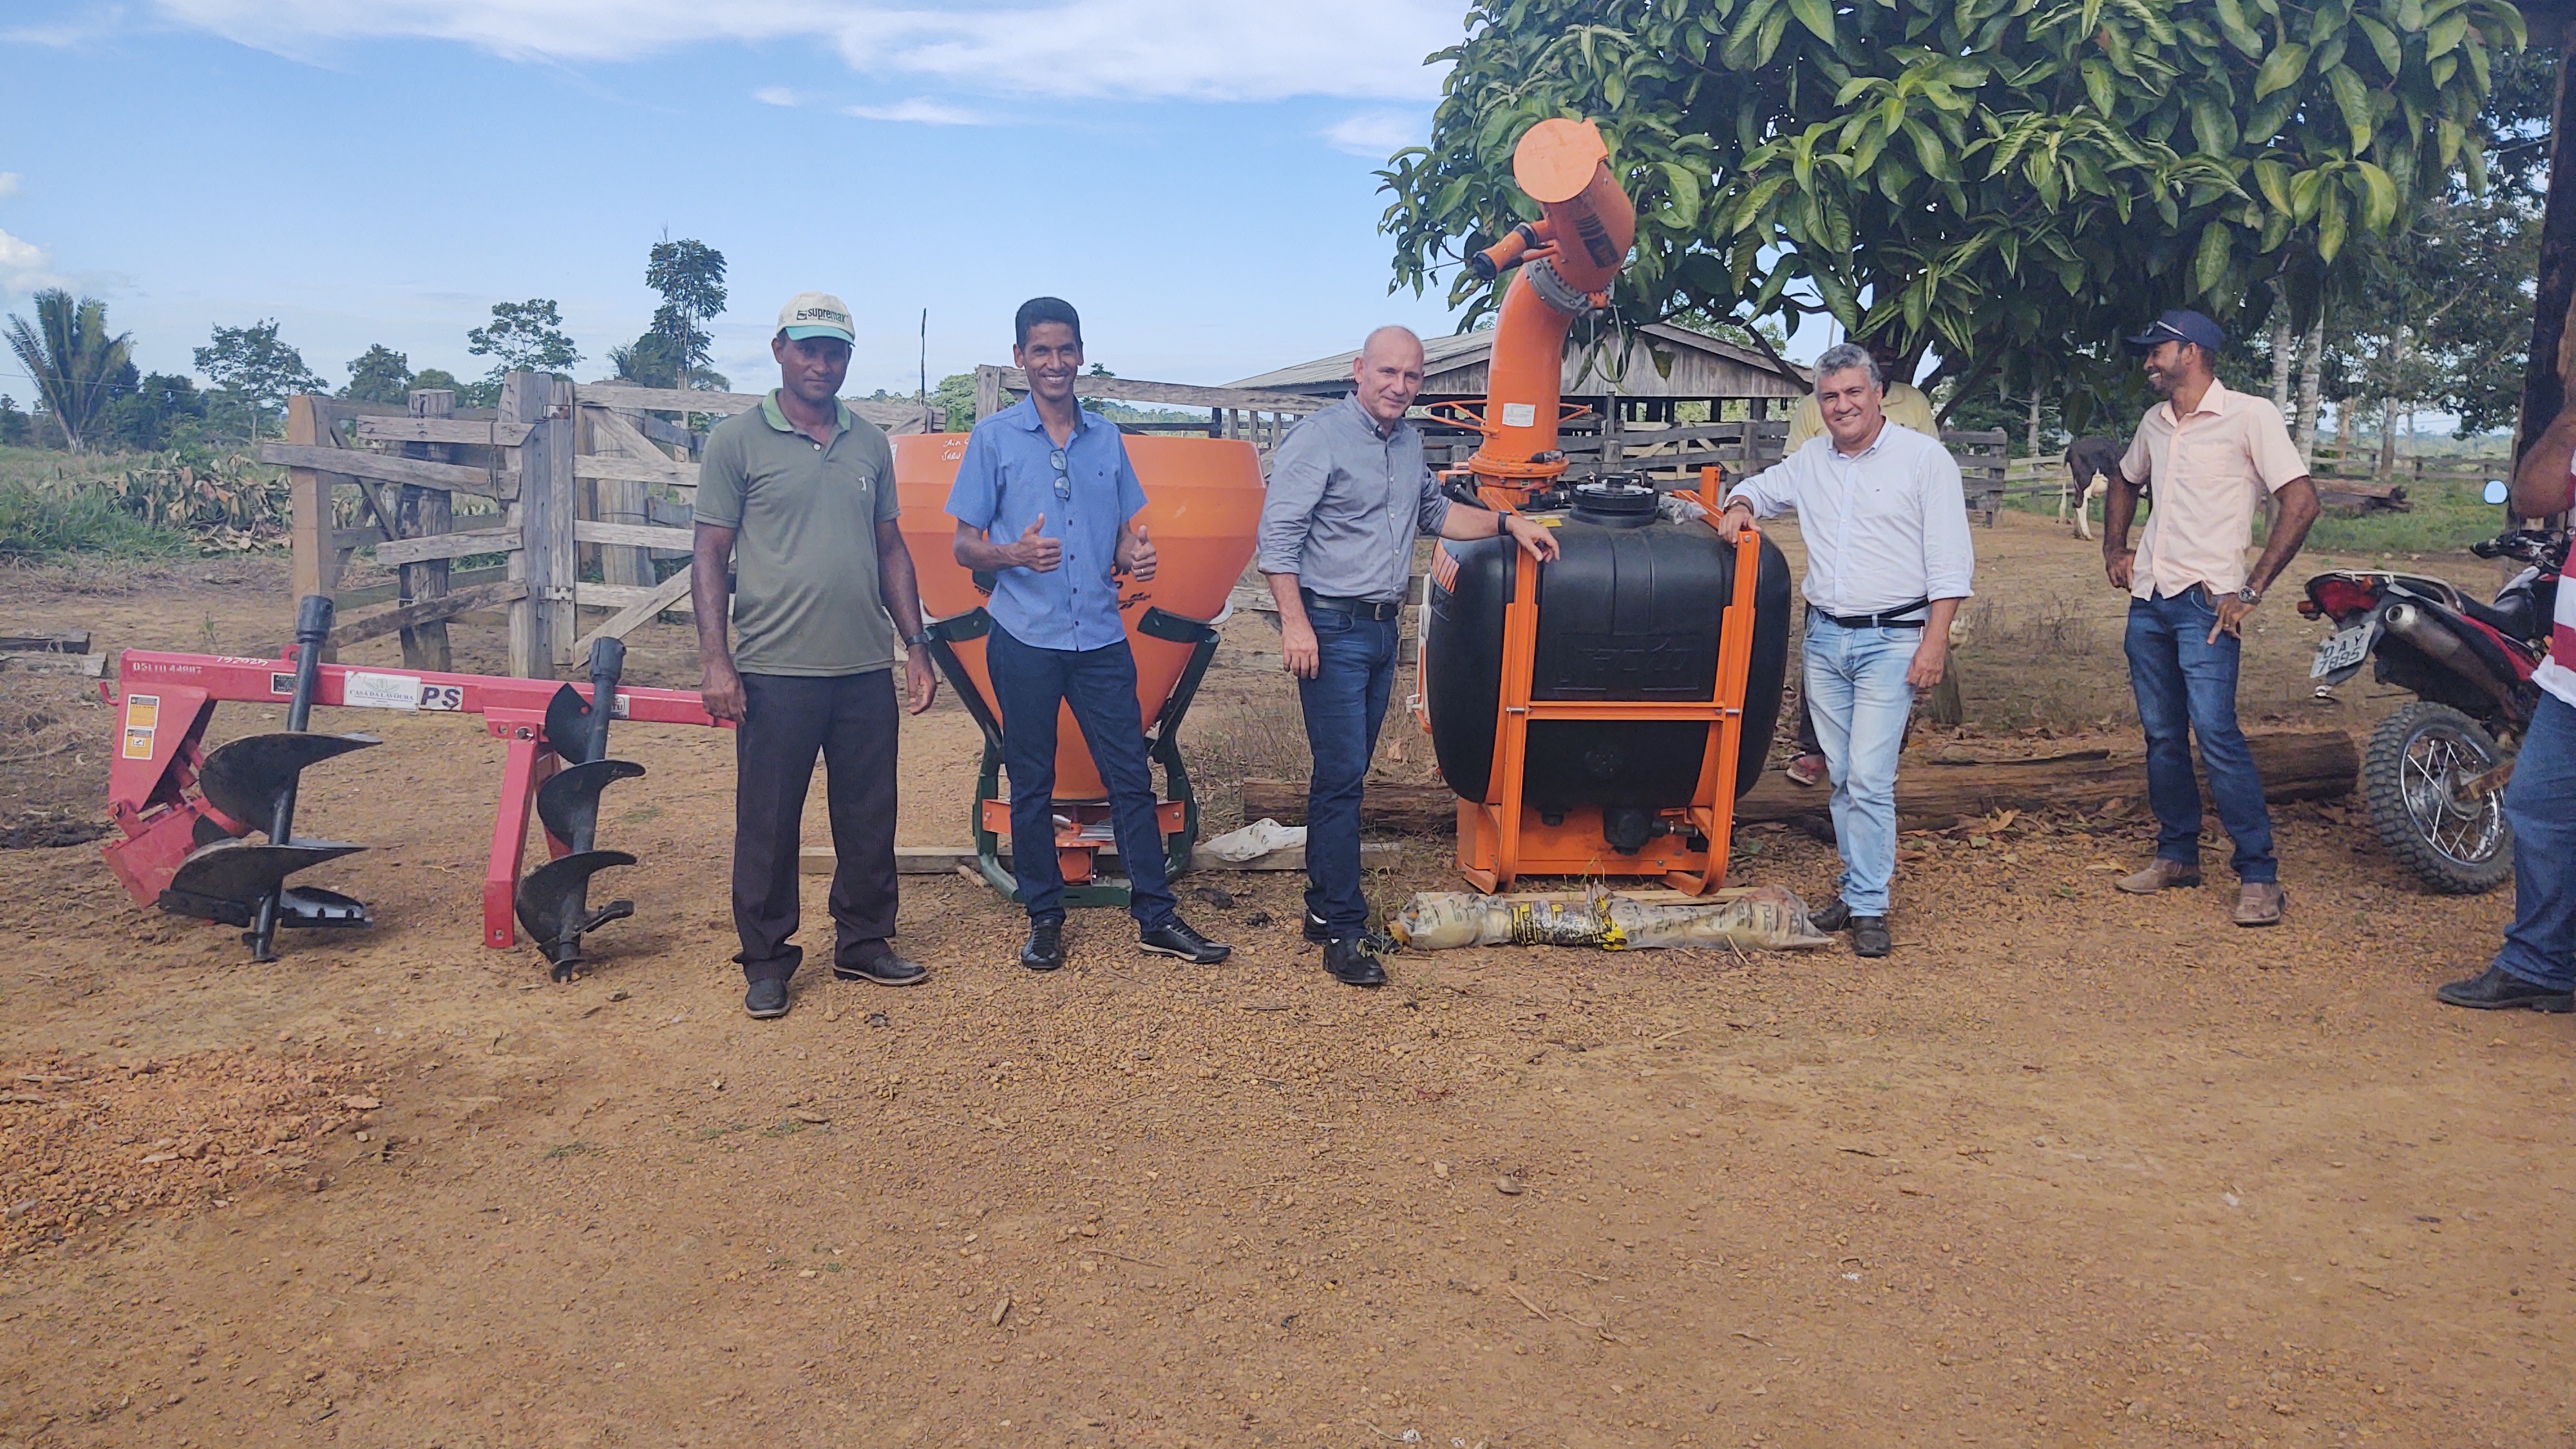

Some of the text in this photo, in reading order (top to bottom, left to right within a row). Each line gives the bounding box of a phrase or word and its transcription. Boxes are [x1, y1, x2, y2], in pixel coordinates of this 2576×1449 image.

[808, 308, 846, 323] supremax
[2318, 647, 2362, 674] 7895
[421, 687, 461, 708] PS
